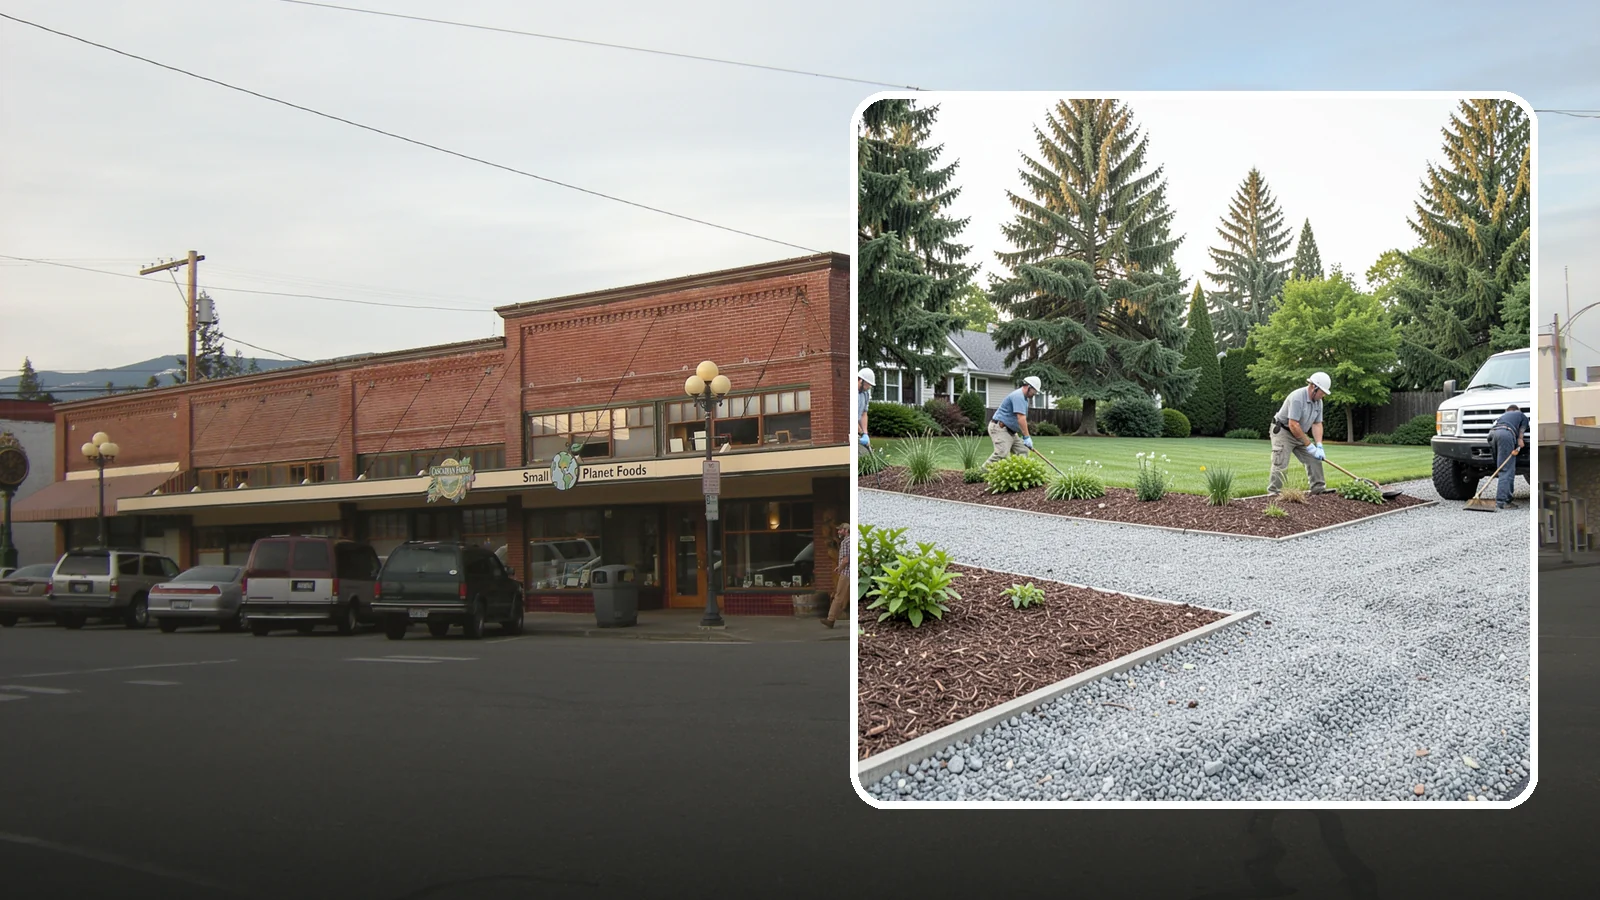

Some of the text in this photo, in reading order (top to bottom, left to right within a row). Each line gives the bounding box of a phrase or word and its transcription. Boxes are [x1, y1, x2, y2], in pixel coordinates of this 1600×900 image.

[523, 464, 647, 483] Small Planet Foods
